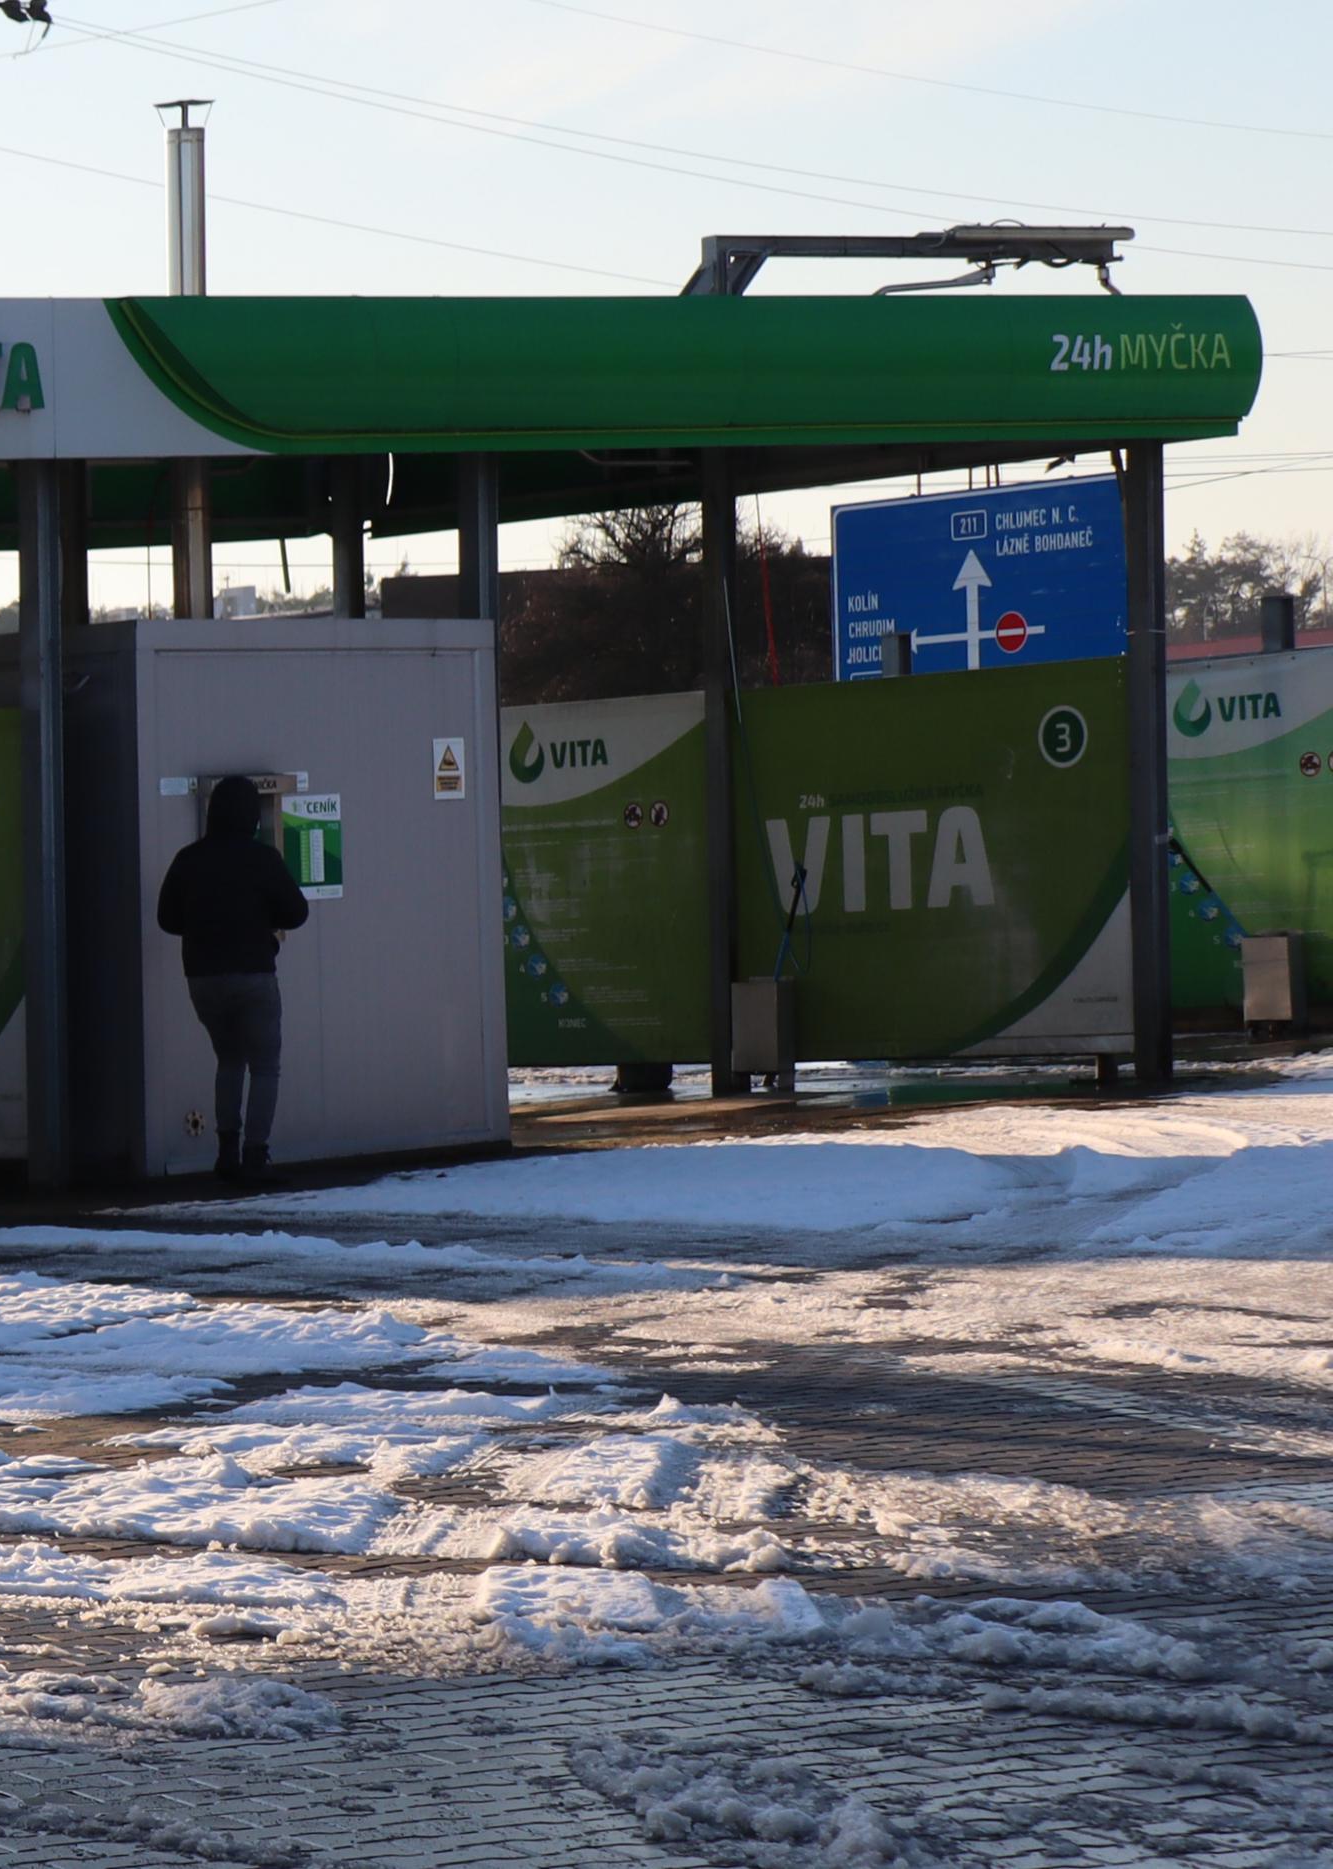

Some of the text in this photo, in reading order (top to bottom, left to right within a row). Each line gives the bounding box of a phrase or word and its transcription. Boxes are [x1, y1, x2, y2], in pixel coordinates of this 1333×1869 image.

[1050, 322, 1231, 371] 24h MYČKA
[960, 516, 978, 535] 211
[995, 508, 1046, 531] CHLUMEC
[1052, 506, 1063, 525] N.
[996, 525, 1093, 557] LÁZNĚ BOHDANEČ
[848, 590, 880, 613] KOLÍN
[848, 619, 895, 639] CHRUDIM
[1217, 691, 1281, 723] VITA
[1055, 722, 1071, 753] 3
[550, 738, 608, 769] VITA
[306, 797, 337, 814] CENÍK
[799, 793, 825, 809] 24h
[765, 806, 995, 916] VITA
